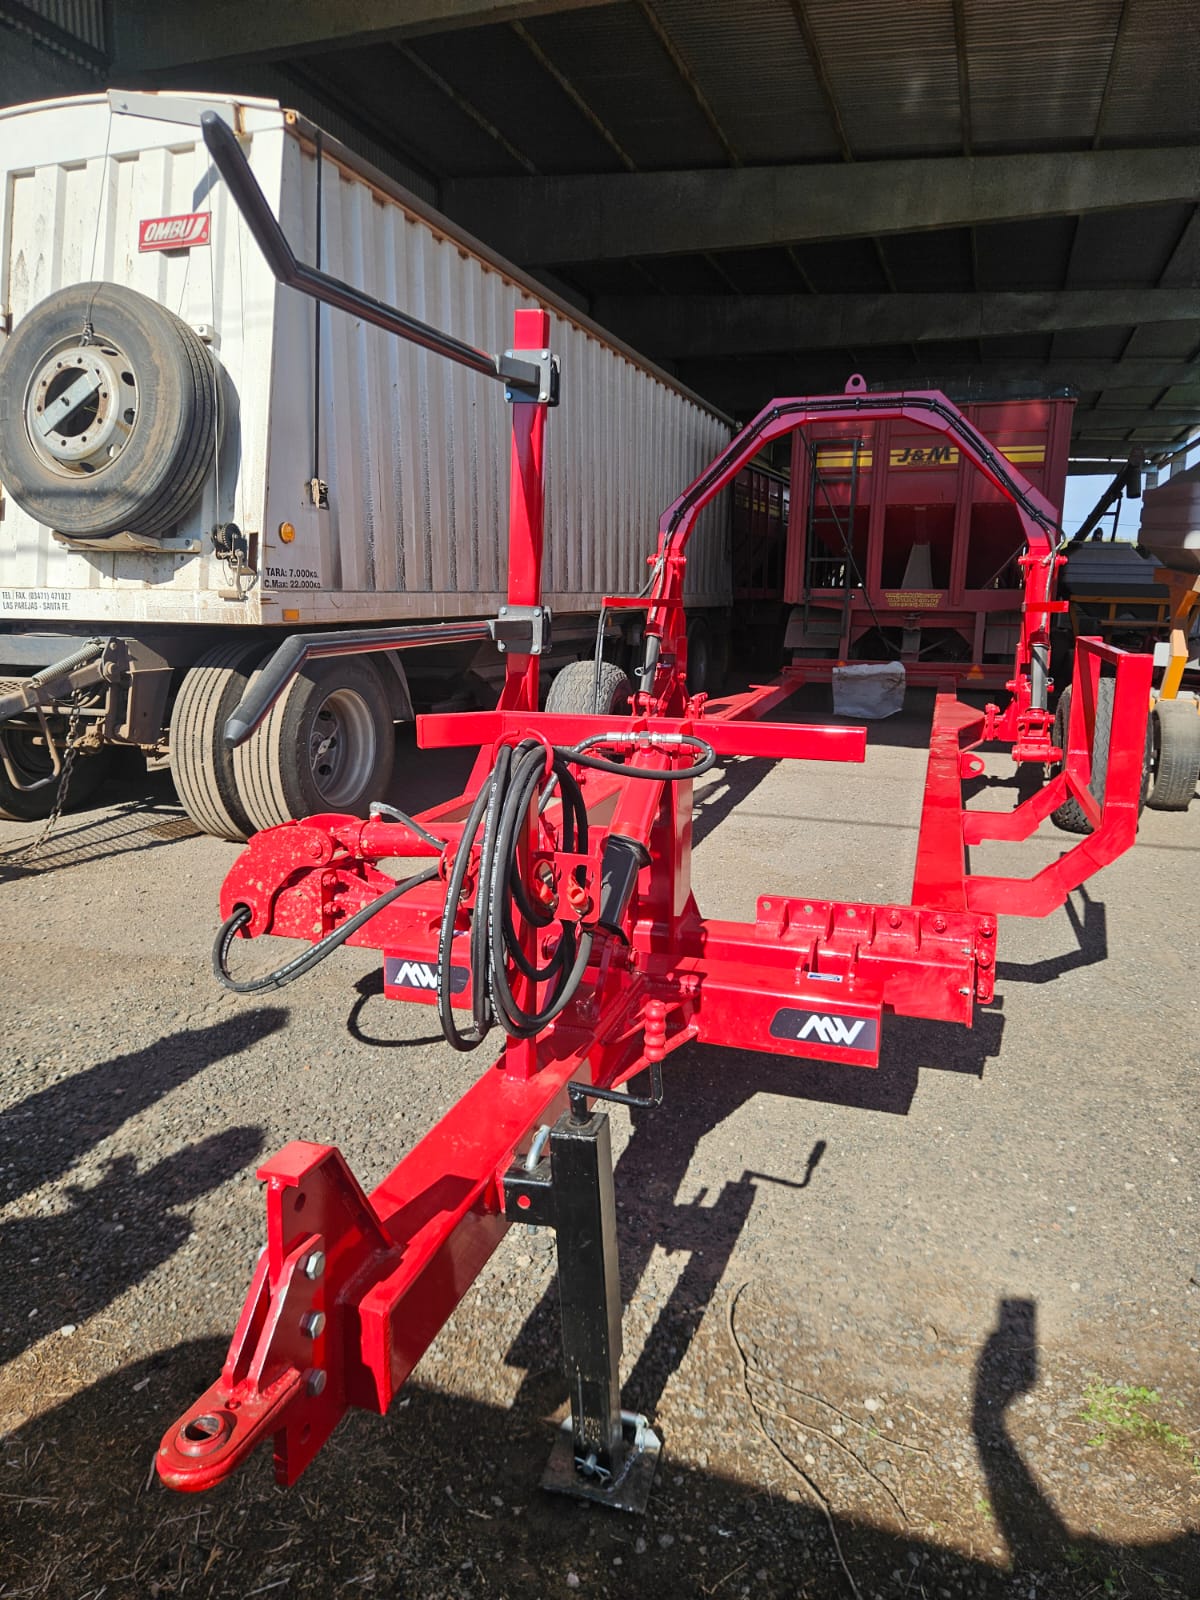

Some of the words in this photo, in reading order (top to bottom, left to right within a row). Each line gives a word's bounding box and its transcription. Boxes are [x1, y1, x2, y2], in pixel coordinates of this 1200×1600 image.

[144, 218, 195, 242] OMBU
[897, 446, 951, 463] J&M
[265, 568, 287, 577] TARA:
[14, 601, 38, 610] PAREJAS
[42, 602, 61, 611] SANTA
